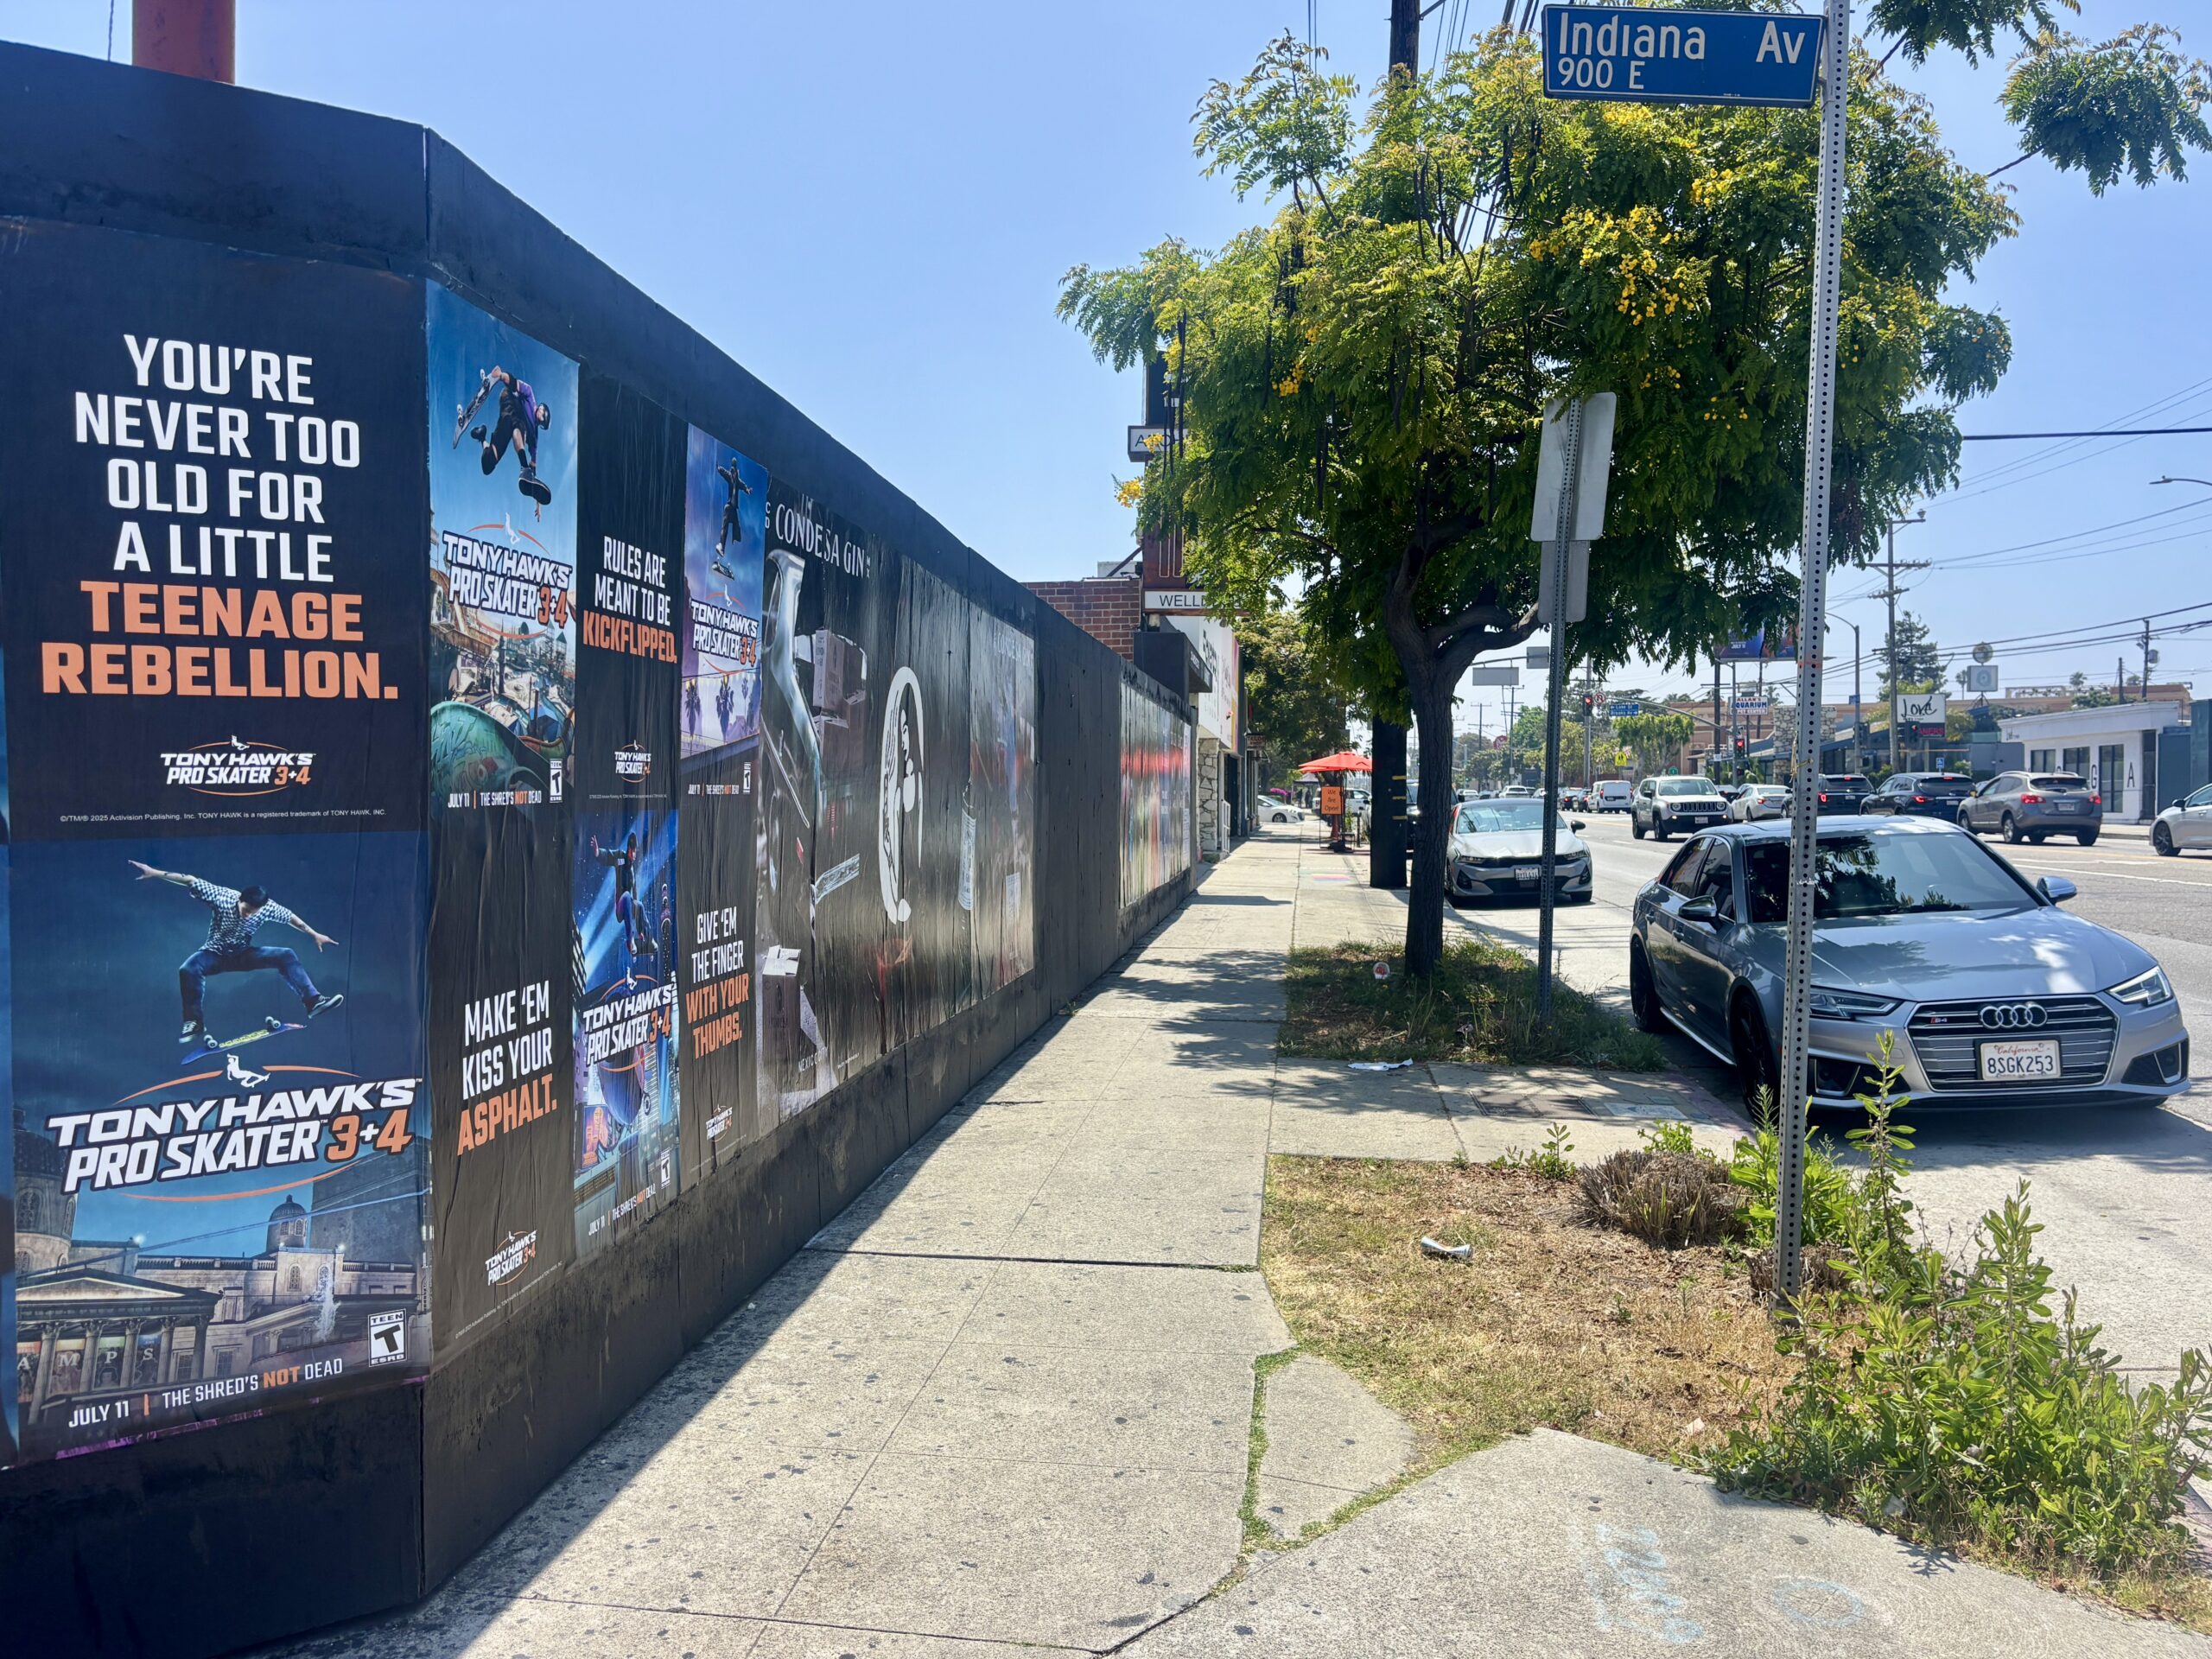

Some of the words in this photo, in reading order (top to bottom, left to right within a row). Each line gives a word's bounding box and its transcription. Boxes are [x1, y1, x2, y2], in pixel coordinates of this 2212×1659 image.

[1559, 12, 1706, 60] Indiana
[1755, 21, 1805, 64] Av
[1558, 57, 1613, 88] 900
[1630, 60, 1645, 90] E
[124, 334, 314, 405] YOU'RE
[75, 391, 251, 459] NEVER
[265, 411, 360, 468] TOO
[107, 458, 208, 514] OLD
[227, 468, 325, 523] FOR
[113, 521, 151, 572] A
[169, 524, 334, 582] LITTLE
[443, 533, 503, 574] TONY
[502, 550, 571, 589] HAWK'S
[604, 536, 642, 581] RULES
[643, 551, 666, 588] ARE
[775, 503, 839, 567] CONDESA
[843, 541, 865, 578] GIN
[80, 581, 363, 641] TEENAGE
[448, 565, 482, 607] PRO
[482, 575, 539, 618] SKATER
[537, 587, 568, 628] 3+4
[594, 573, 639, 617] MEANT
[641, 588, 655, 622] TO
[657, 593, 671, 626] BE
[691, 601, 723, 627] TONY
[722, 610, 758, 638] HAWK'S
[582, 610, 677, 664] KICKFLIPPED.
[693, 623, 711, 652] PRO
[711, 628, 741, 660] SKATER
[741, 636, 756, 667] 3+4
[41, 642, 398, 699] REBELLION.
[160, 753, 228, 766] TONY
[228, 753, 313, 766] HAWK'S
[167, 767, 205, 785] PRO
[205, 766, 271, 784] SKATER
[274, 766, 310, 785] 3+4
[614, 751, 633, 761] TONY
[615, 761, 626, 774] PRO
[625, 761, 643, 775] SKATER
[448, 792, 463, 808] JULY
[464, 792, 470, 807] 11
[480, 792, 491, 806] THE
[514, 791, 528, 804] NOT
[528, 791, 542, 804] DEAD
[551, 771, 561, 793] T
[696, 910, 719, 944] GIVE
[721, 906, 737, 938] 'EM
[691, 949, 710, 984] THE
[712, 940, 744, 977] FINGER
[465, 989, 517, 1047] MAKE
[521, 980, 550, 1026] 'EM
[582, 999, 625, 1033] TONY
[624, 984, 672, 1018] HAWK'S
[685, 983, 717, 1024] WITH
[720, 973, 749, 1010] YOUR
[587, 1027, 611, 1065] PRO
[610, 1013, 651, 1055] SKATER
[649, 1005, 671, 1042] 3+4
[693, 1012, 742, 1059] THUMBS.
[1997, 1045, 2039, 1056] California
[462, 1045, 504, 1101] KISS
[508, 1027, 553, 1080] YOUR
[798, 1052, 817, 1071] MEXICO
[1987, 1055, 2054, 1074] 8SGK253
[48, 1100, 219, 1147] TONY
[219, 1078, 416, 1127] HAWK'S
[457, 1072, 557, 1156] ASPHALT.
[64, 1140, 159, 1192] PRO
[161, 1120, 321, 1179] SKATER
[325, 1109, 413, 1160] 3+4
[588, 1217, 601, 1236] JULY
[612, 1206, 620, 1220] THE
[636, 1189, 646, 1205] NOT
[485, 1247, 509, 1271] TONY
[508, 1230, 537, 1257] HAWK'S
[487, 1263, 501, 1286] PRO
[500, 1250, 524, 1277] SKATER
[523, 1243, 537, 1263] 3+4
[371, 1313, 403, 1324] TEEN
[373, 1324, 401, 1353] T
[372, 1354, 404, 1364] ESRB
[68, 1406, 110, 1428] JULY
[114, 1401, 130, 1418] 11
[162, 1388, 191, 1409] THE
[195, 1375, 259, 1403] SHRED'S
[263, 1365, 301, 1389] NOT
[304, 1358, 343, 1380] DEAD
